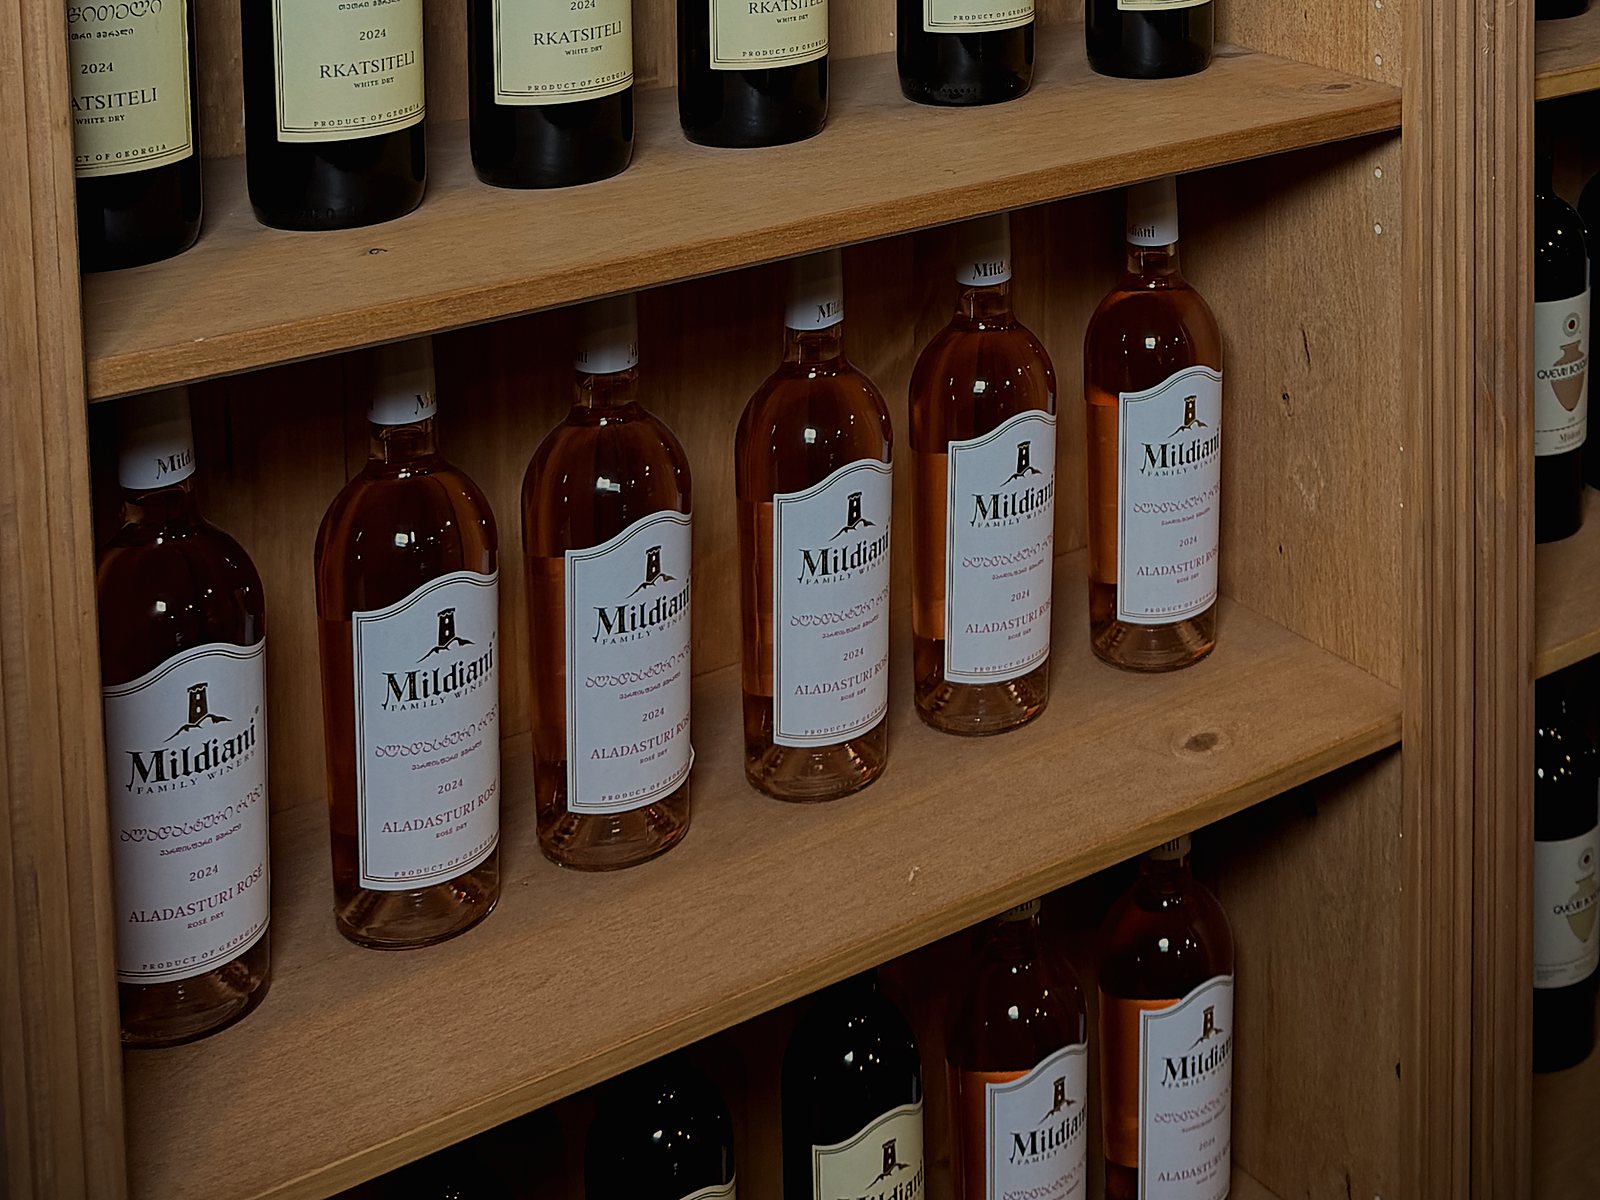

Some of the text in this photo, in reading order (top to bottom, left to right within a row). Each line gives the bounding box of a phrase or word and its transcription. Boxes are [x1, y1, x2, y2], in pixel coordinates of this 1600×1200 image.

[570, 0, 596, 11] 2024
[953, 13, 993, 21] PRODUCT
[360, 29, 386, 41] 2024
[533, 20, 622, 46] RKATSITELI
[565, 48, 588, 56] WHITE
[742, 48, 786, 57] PRODUCT
[80, 62, 114, 74] 2024
[320, 50, 415, 79] RKATSITELI
[354, 77, 394, 88] WHITE DRY
[527, 82, 576, 91] PRODUCT
[72, 87, 157, 111] ATSITELI
[75, 114, 125, 125] WHITE DRY
[314, 117, 366, 127] PRODUCT
[95, 153, 111, 161] OF
[115, 143, 167, 158] GEORGIA
[1140, 428, 1219, 475] Mildiani
[155, 449, 191, 479] Mild
[970, 474, 1054, 527] Mildiani
[797, 525, 889, 584] Mildiani
[1136, 555, 1205, 576] ALADASTURI
[806, 573, 852, 585] FAMILY
[592, 578, 689, 643] Mildiani
[965, 610, 1037, 634] ALADASTURI
[602, 629, 652, 645] FAMILY
[843, 648, 864, 661] 2024
[381, 642, 493, 710] Mildiani
[794, 668, 873, 696] ALADASTURI
[392, 697, 445, 711] FAMILY
[642, 707, 665, 722] 2024
[804, 724, 847, 735] PRODUCT
[591, 728, 675, 760] ALADASTURI
[125, 717, 256, 792] Mildiani
[137, 750, 255, 794] FAMILY WINERY
[438, 779, 463, 794] 2024
[602, 783, 660, 801] PRODUCT OF
[382, 800, 475, 833] ALADASTURI
[189, 864, 218, 882] 2024
[394, 858, 460, 877] PRODUCT OF
[128, 887, 233, 923] ALADASTURI
[211, 910, 225, 922] DRY
[142, 924, 258, 970] PRODUCT OF GEORGIA
[1161, 1034, 1233, 1087] Mildian
[1009, 1104, 1086, 1164] Mildian
